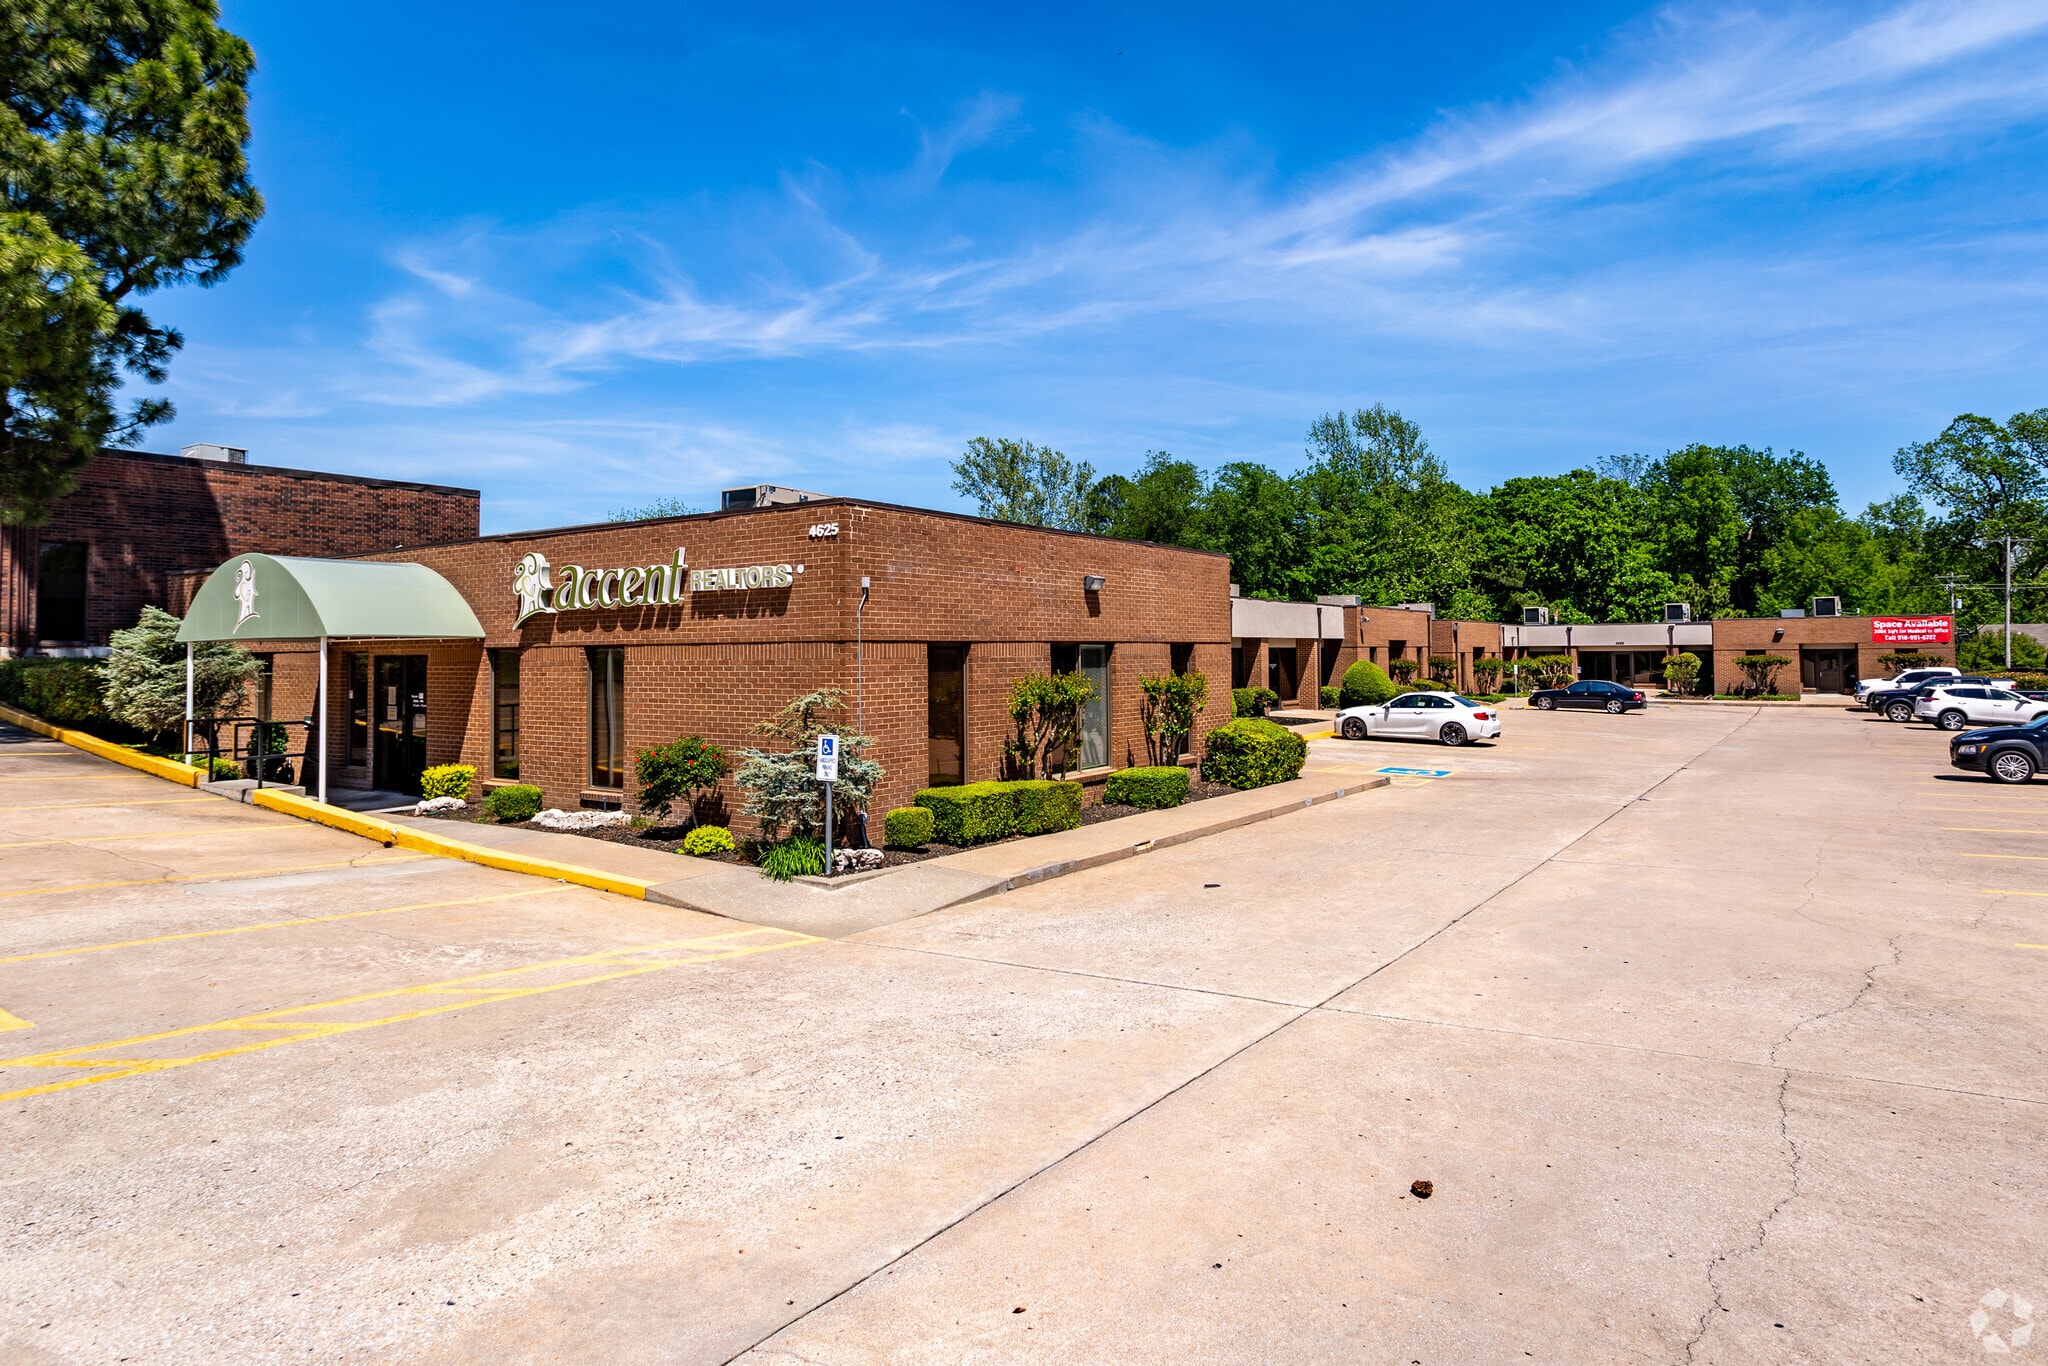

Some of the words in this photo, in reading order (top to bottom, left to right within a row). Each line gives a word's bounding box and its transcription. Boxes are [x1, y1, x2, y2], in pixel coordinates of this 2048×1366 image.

[808, 523, 839, 537] 4625
[554, 547, 688, 611] accent
[690, 564, 793, 591] REALTORS
[1874, 621, 1902, 629] Space
